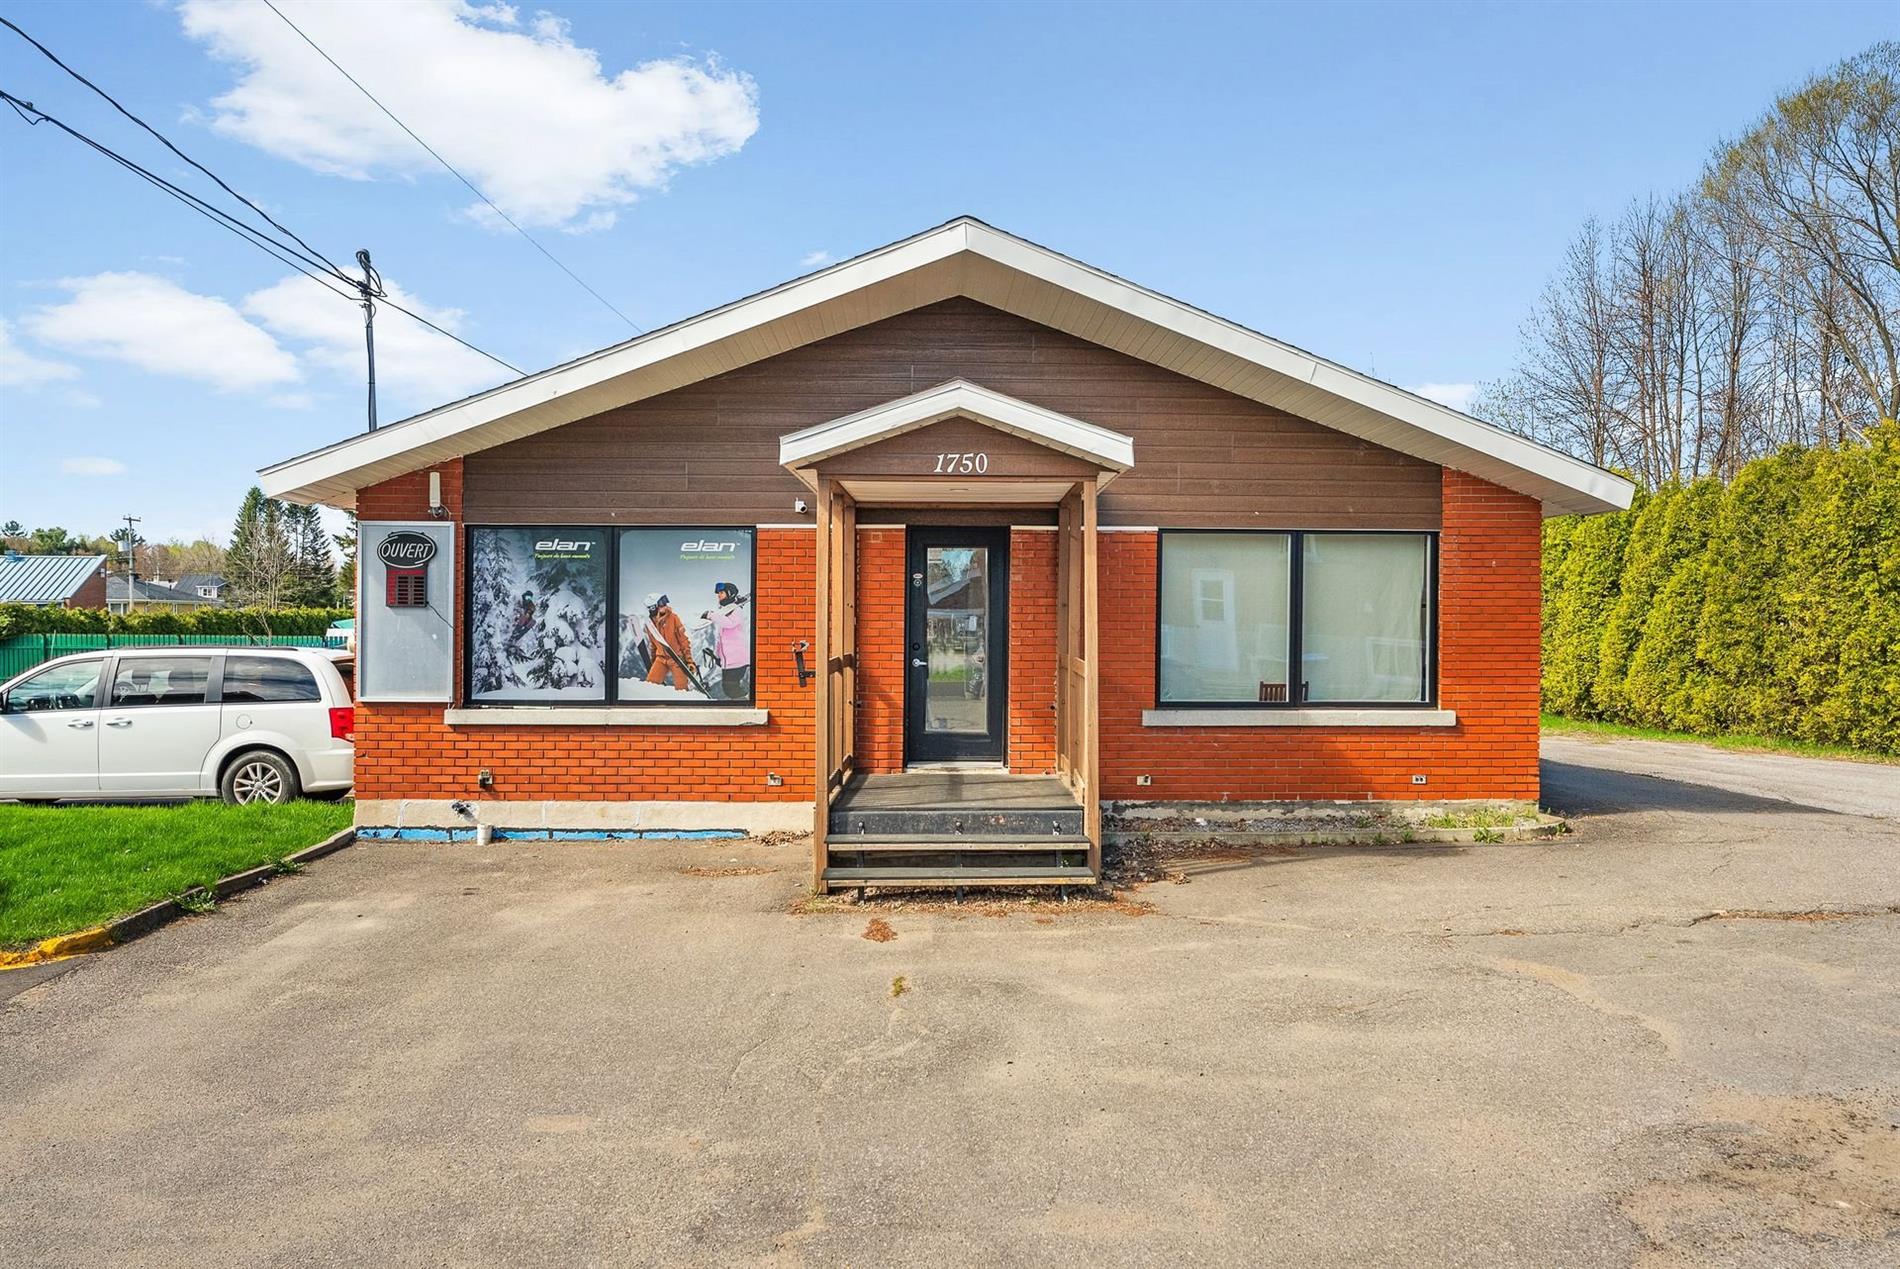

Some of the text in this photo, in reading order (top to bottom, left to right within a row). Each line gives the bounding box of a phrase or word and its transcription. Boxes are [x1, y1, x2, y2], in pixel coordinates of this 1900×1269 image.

[933, 453, 988, 473] 1750
[381, 543, 431, 558] OUVERT
[535, 539, 590, 551] elan
[681, 540, 735, 552] elan
